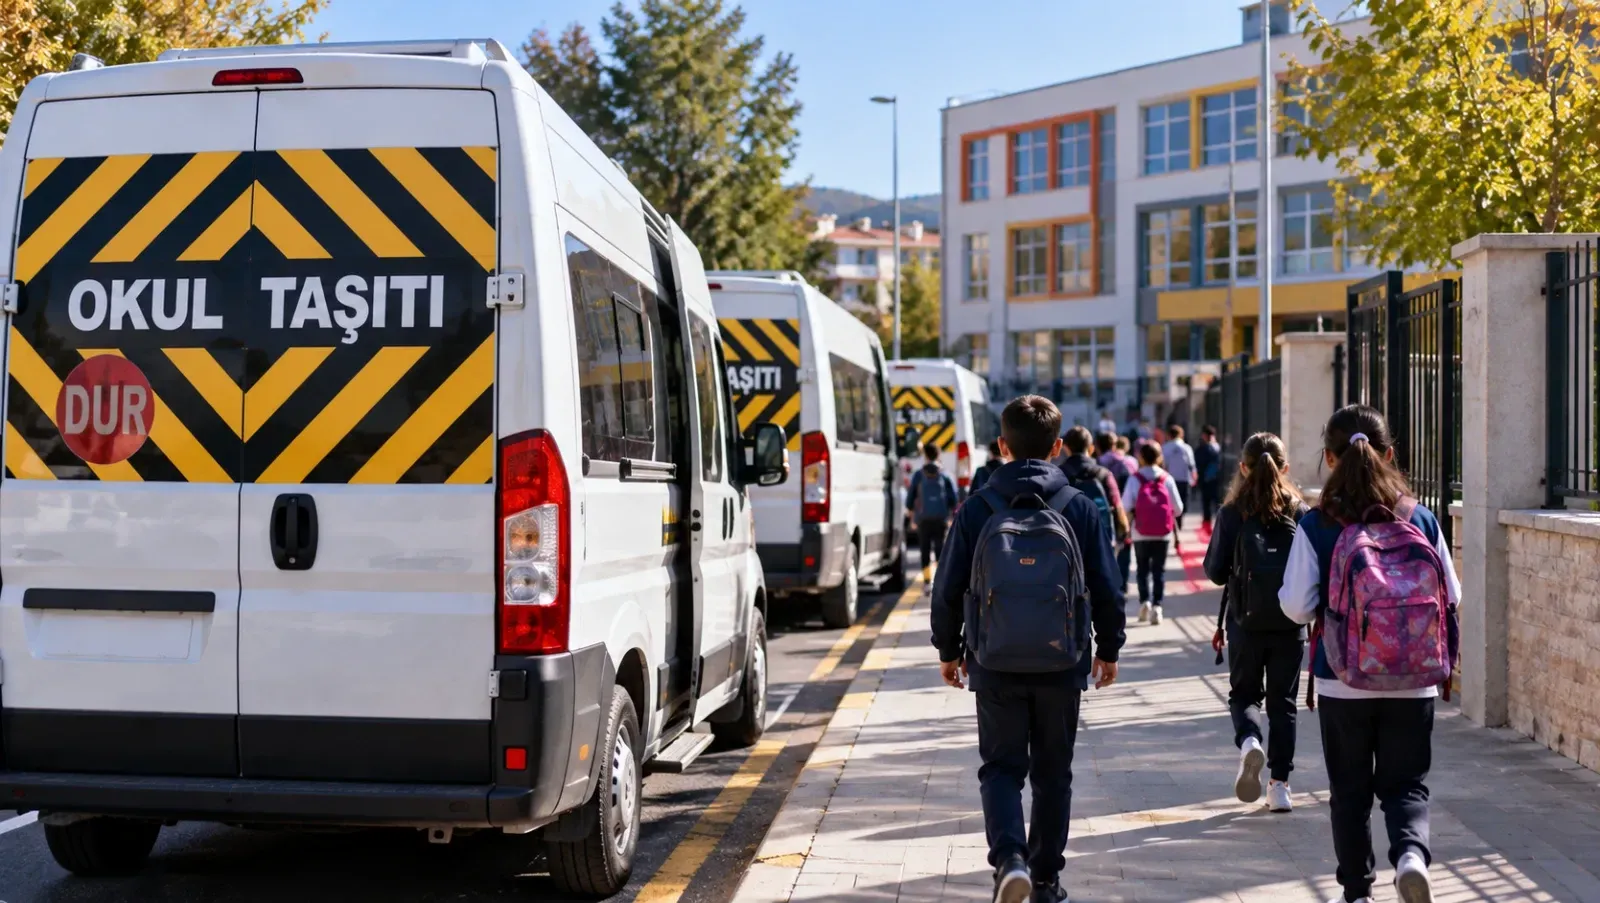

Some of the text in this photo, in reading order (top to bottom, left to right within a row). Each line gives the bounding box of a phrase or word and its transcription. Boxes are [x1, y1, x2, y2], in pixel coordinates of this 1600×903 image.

[68, 275, 444, 345] OKUL TAŞITI
[727, 365, 781, 395] AŞITI
[64, 384, 147, 435] DUR
